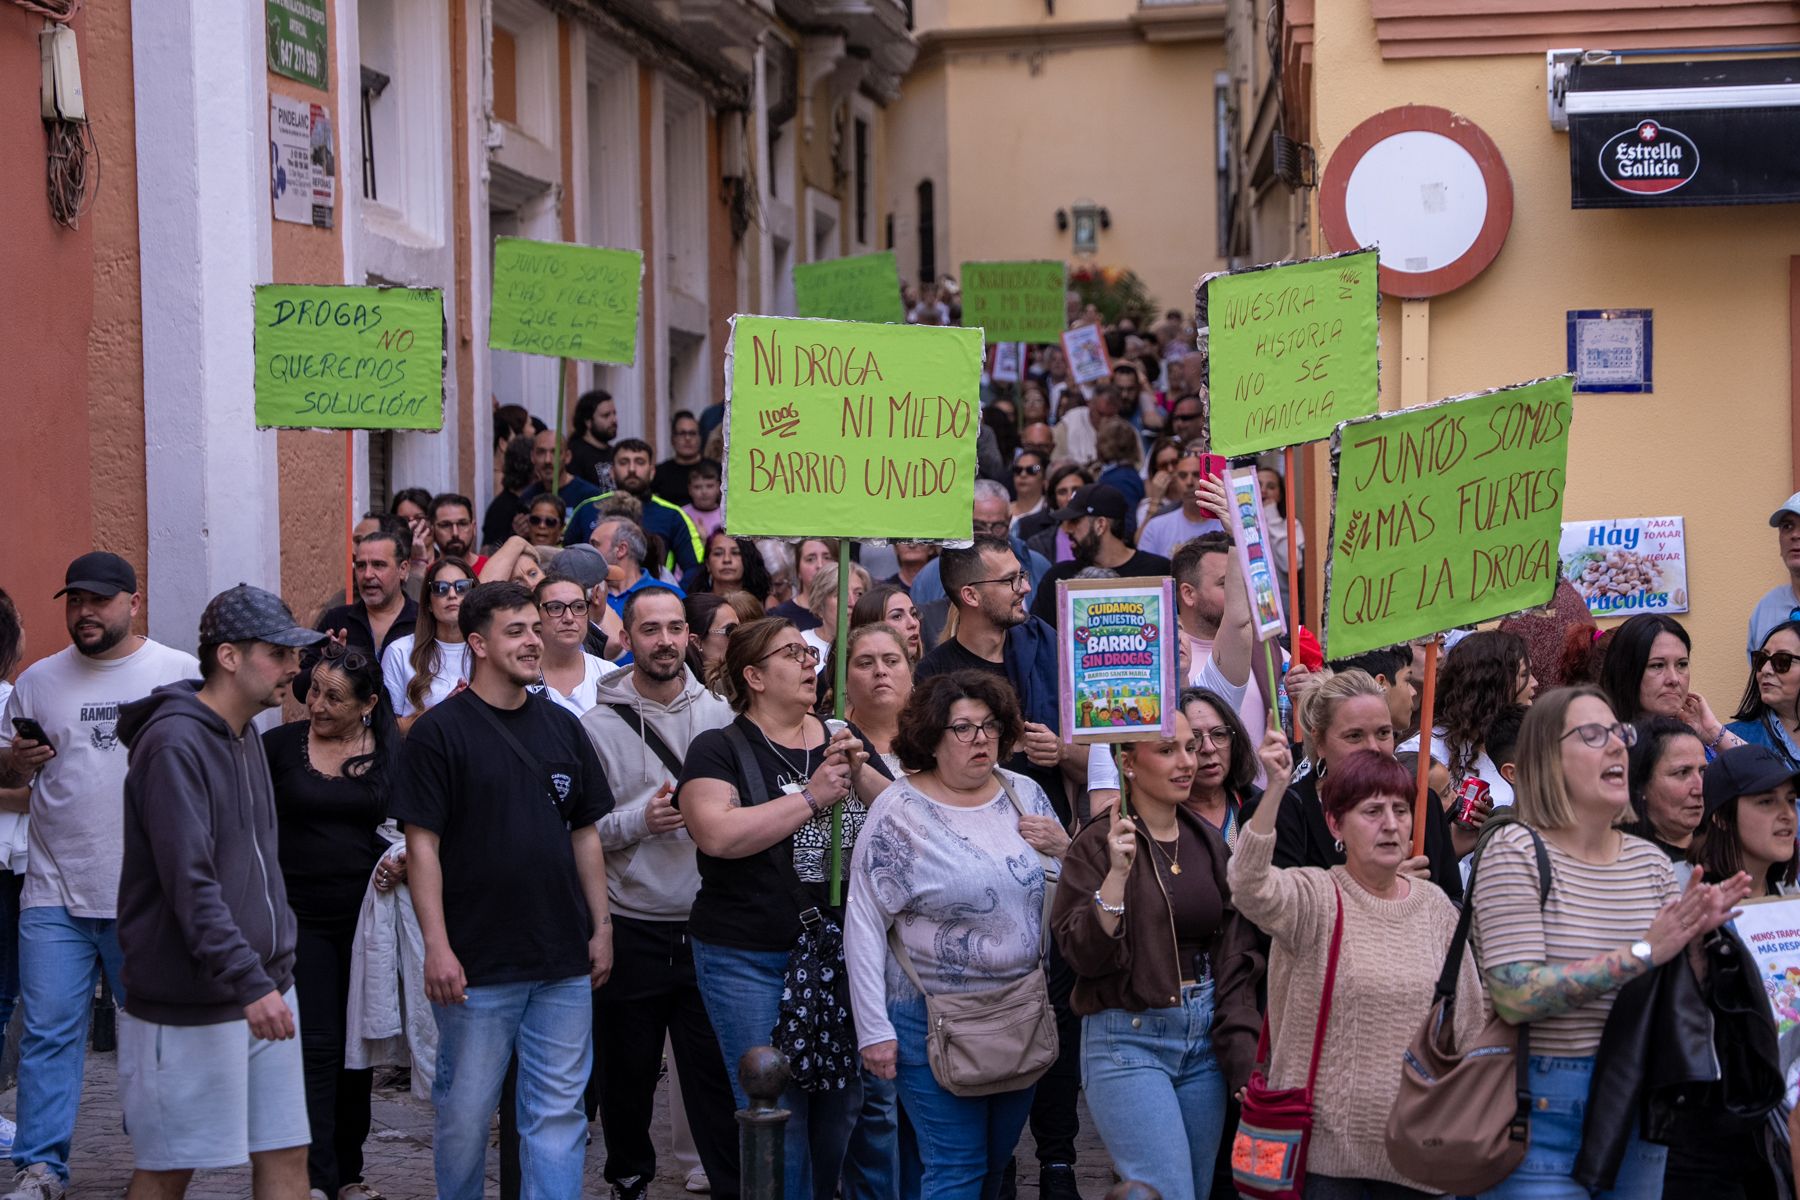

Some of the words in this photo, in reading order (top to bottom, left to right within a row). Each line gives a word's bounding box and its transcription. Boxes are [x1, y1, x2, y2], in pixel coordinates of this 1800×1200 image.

[280, 38, 294, 69] 647
[1615, 142, 1683, 160] Estrella
[1618, 159, 1680, 177] Galicia
[504, 253, 568, 279] JUNTOS
[268, 300, 382, 334] DROGAS
[519, 307, 558, 328] QUE
[571, 313, 598, 330] LA
[1224, 284, 1315, 330] NUESTRA
[377, 329, 415, 352] NO
[512, 329, 583, 351] DROGA
[1256, 318, 1343, 358] HISTORIA
[269, 352, 407, 388] QUEREMOS
[753, 329, 783, 387] NI
[794, 343, 884, 387] DROGA
[1235, 372, 1265, 402] NO
[1295, 354, 1331, 383] SE
[295, 390, 428, 416] SOLUCIÓN
[841, 394, 873, 438] NI
[889, 391, 970, 439] MIEDO
[1245, 390, 1335, 439] MANCHA
[1354, 414, 1468, 492] JUNTOS
[1473, 400, 1568, 460] SOMOS
[749, 448, 846, 494] BARRIO
[864, 455, 956, 500] UNIDO
[1376, 493, 1436, 551] MÁS
[1457, 468, 1561, 534] FUERTES
[1643, 530, 1681, 540] TOMAR
[1647, 519, 1675, 528] PARA
[1588, 526, 1640, 550] Hay
[1343, 568, 1406, 625] QUE
[1416, 557, 1454, 610] LA
[1471, 539, 1550, 602] DROGA
[1088, 603, 1144, 615] CUIDAMOS
[1102, 614, 1146, 626] NUESTRO
[1087, 634, 1147, 654] BARRIO
[1082, 654, 1102, 668] SIN
[1104, 652, 1153, 666] DROGAS
[1087, 671, 1109, 679] BARRIO
[1750, 931, 1776, 943] MENOS
